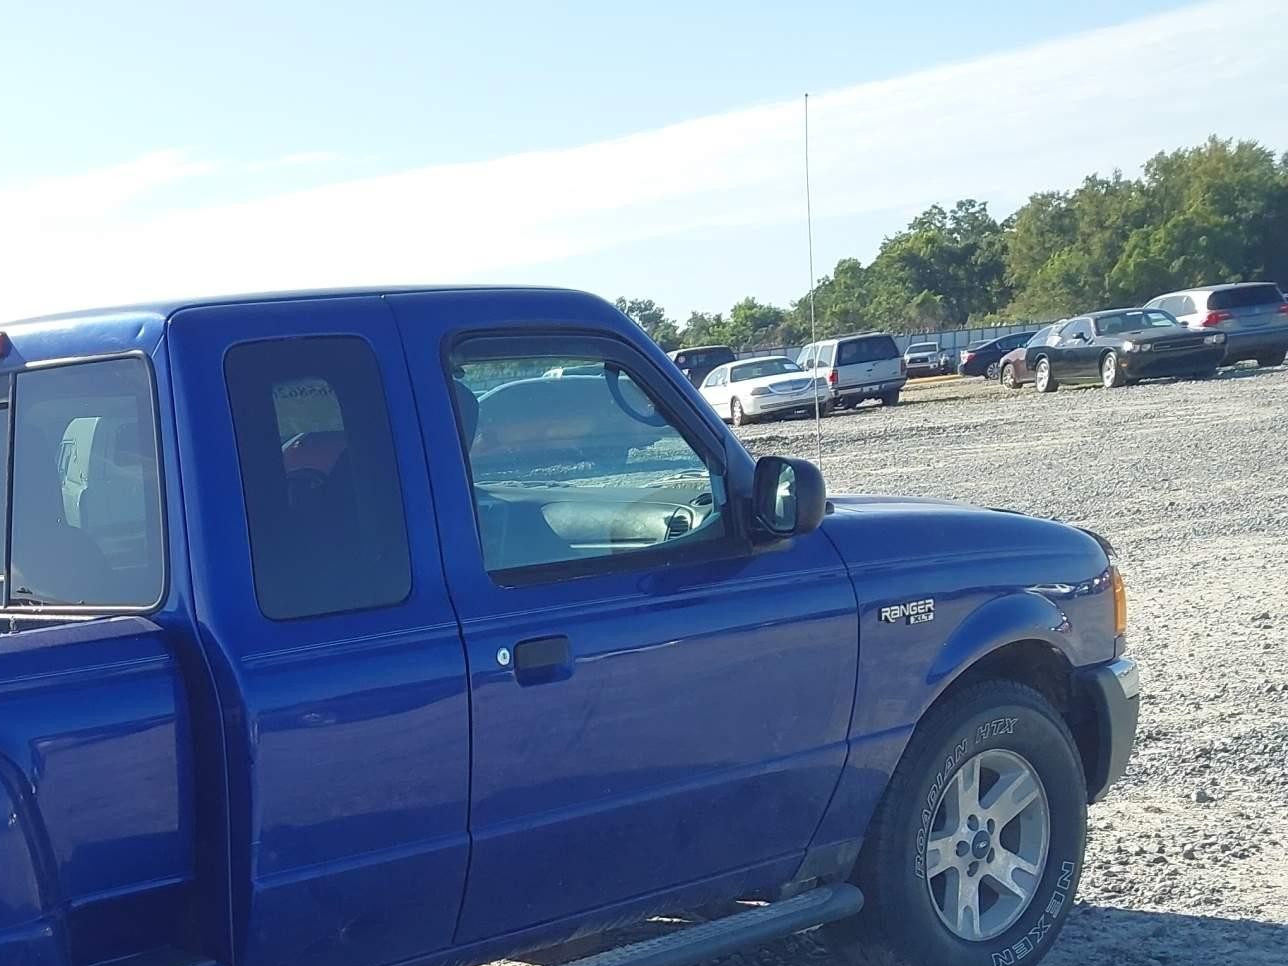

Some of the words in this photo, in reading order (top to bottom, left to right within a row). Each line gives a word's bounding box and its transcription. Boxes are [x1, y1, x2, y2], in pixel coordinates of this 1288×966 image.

[910, 612, 934, 624] XLT
[915, 738, 968, 880] ROADIAN
[976, 718, 1019, 744] HTX
